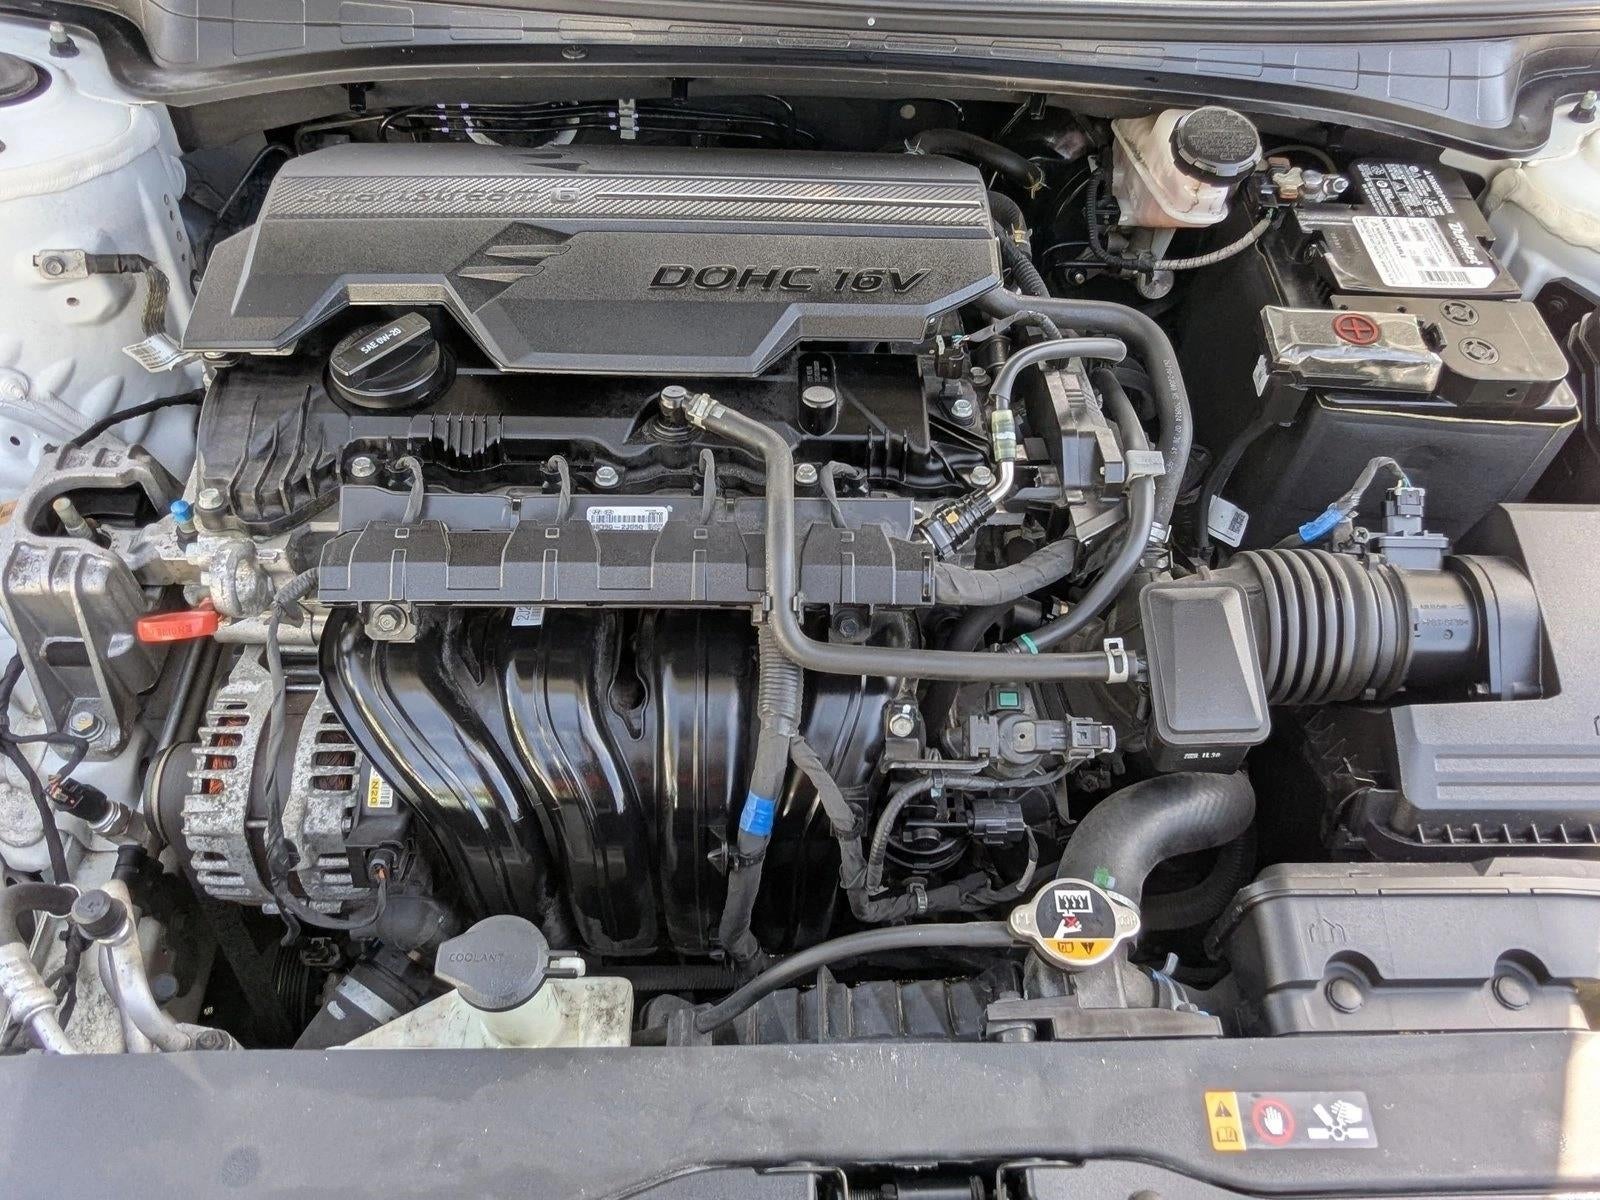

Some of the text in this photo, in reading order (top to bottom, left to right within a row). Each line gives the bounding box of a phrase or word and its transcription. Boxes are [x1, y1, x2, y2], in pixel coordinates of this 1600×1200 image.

[1447, 221, 1484, 266] Duralast
[648, 264, 933, 293] DOHC 16V
[360, 340, 379, 354] SAE
[375, 327, 402, 345] 0W-20
[450, 952, 504, 962] COOLANT
